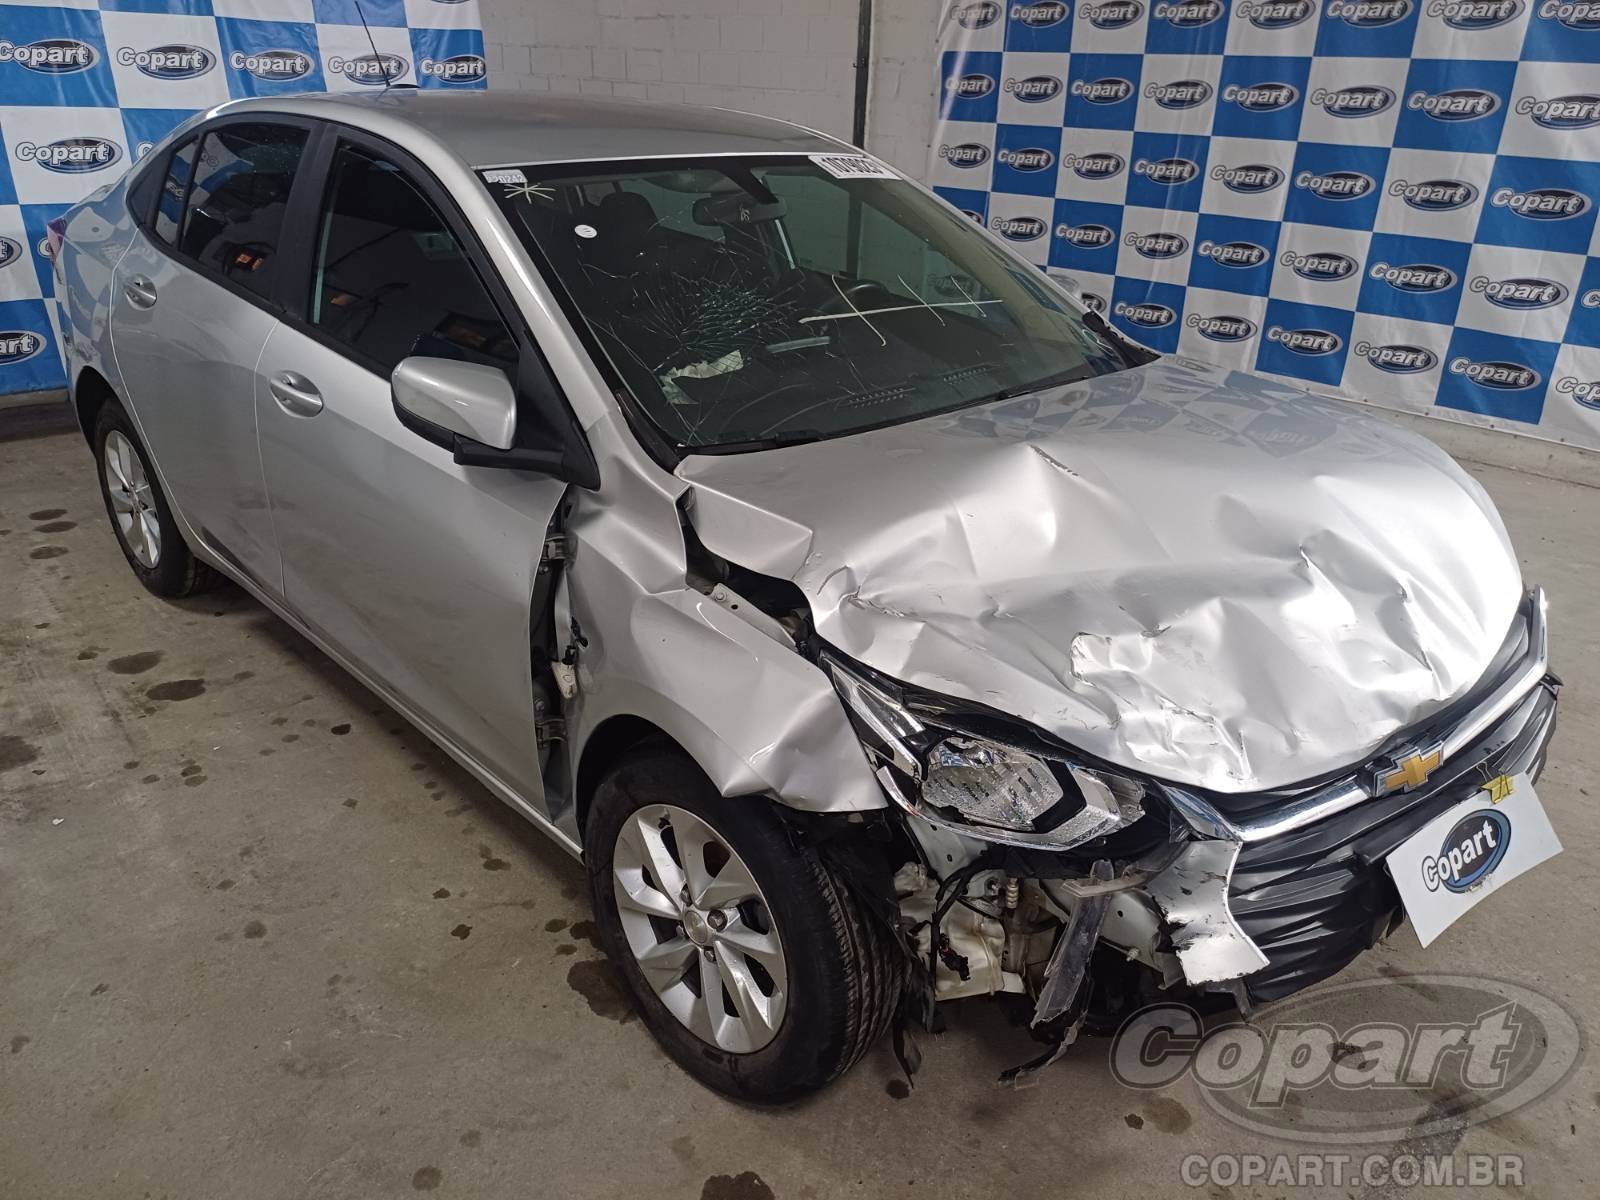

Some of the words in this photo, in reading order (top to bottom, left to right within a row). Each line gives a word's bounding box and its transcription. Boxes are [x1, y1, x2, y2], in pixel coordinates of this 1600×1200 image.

[1010, 3, 1062, 22] Copart
[1079, 2, 1137, 23] Copart
[1154, 2, 1218, 23] Copart
[1236, 0, 1307, 22] Copart
[1327, 0, 1405, 22] Copart
[1427, 0, 1516, 23] Copart
[0, 41, 88, 66] Copart
[117, 47, 203, 74] Copart
[230, 53, 306, 77] Copart
[328, 57, 396, 79] Copart
[420, 59, 483, 78] Copart
[1004, 79, 1057, 100] Copart
[1071, 81, 1127, 102] Copart
[1144, 84, 1204, 104] Copart
[1223, 86, 1291, 107] Copart
[1311, 89, 1384, 109] Copart
[1407, 92, 1489, 113] Copart
[16, 142, 110, 164] Copart
[939, 143, 984, 163] Copart
[998, 150, 1050, 169] Copart
[1063, 155, 1118, 175] Copart
[1134, 158, 1193, 180] Copart
[1211, 166, 1275, 187] Copart
[1296, 171, 1367, 194] Copart
[1389, 180, 1466, 203] Copart
[1492, 188, 1582, 214] Copart
[992, 217, 1041, 236] Copart
[1056, 225, 1108, 244] Copart
[1124, 232, 1181, 254] Copart
[1199, 241, 1264, 264] Copart
[1281, 251, 1350, 275] Copart
[1370, 262, 1449, 288] Copart
[1470, 276, 1560, 301] Copart
[1115, 302, 1169, 323] Copart
[1186, 314, 1249, 337] Copart
[1267, 325, 1335, 350] Copart
[1354, 341, 1428, 366] Copart
[1450, 357, 1531, 385] Copart
[1421, 819, 1496, 892] Copart
